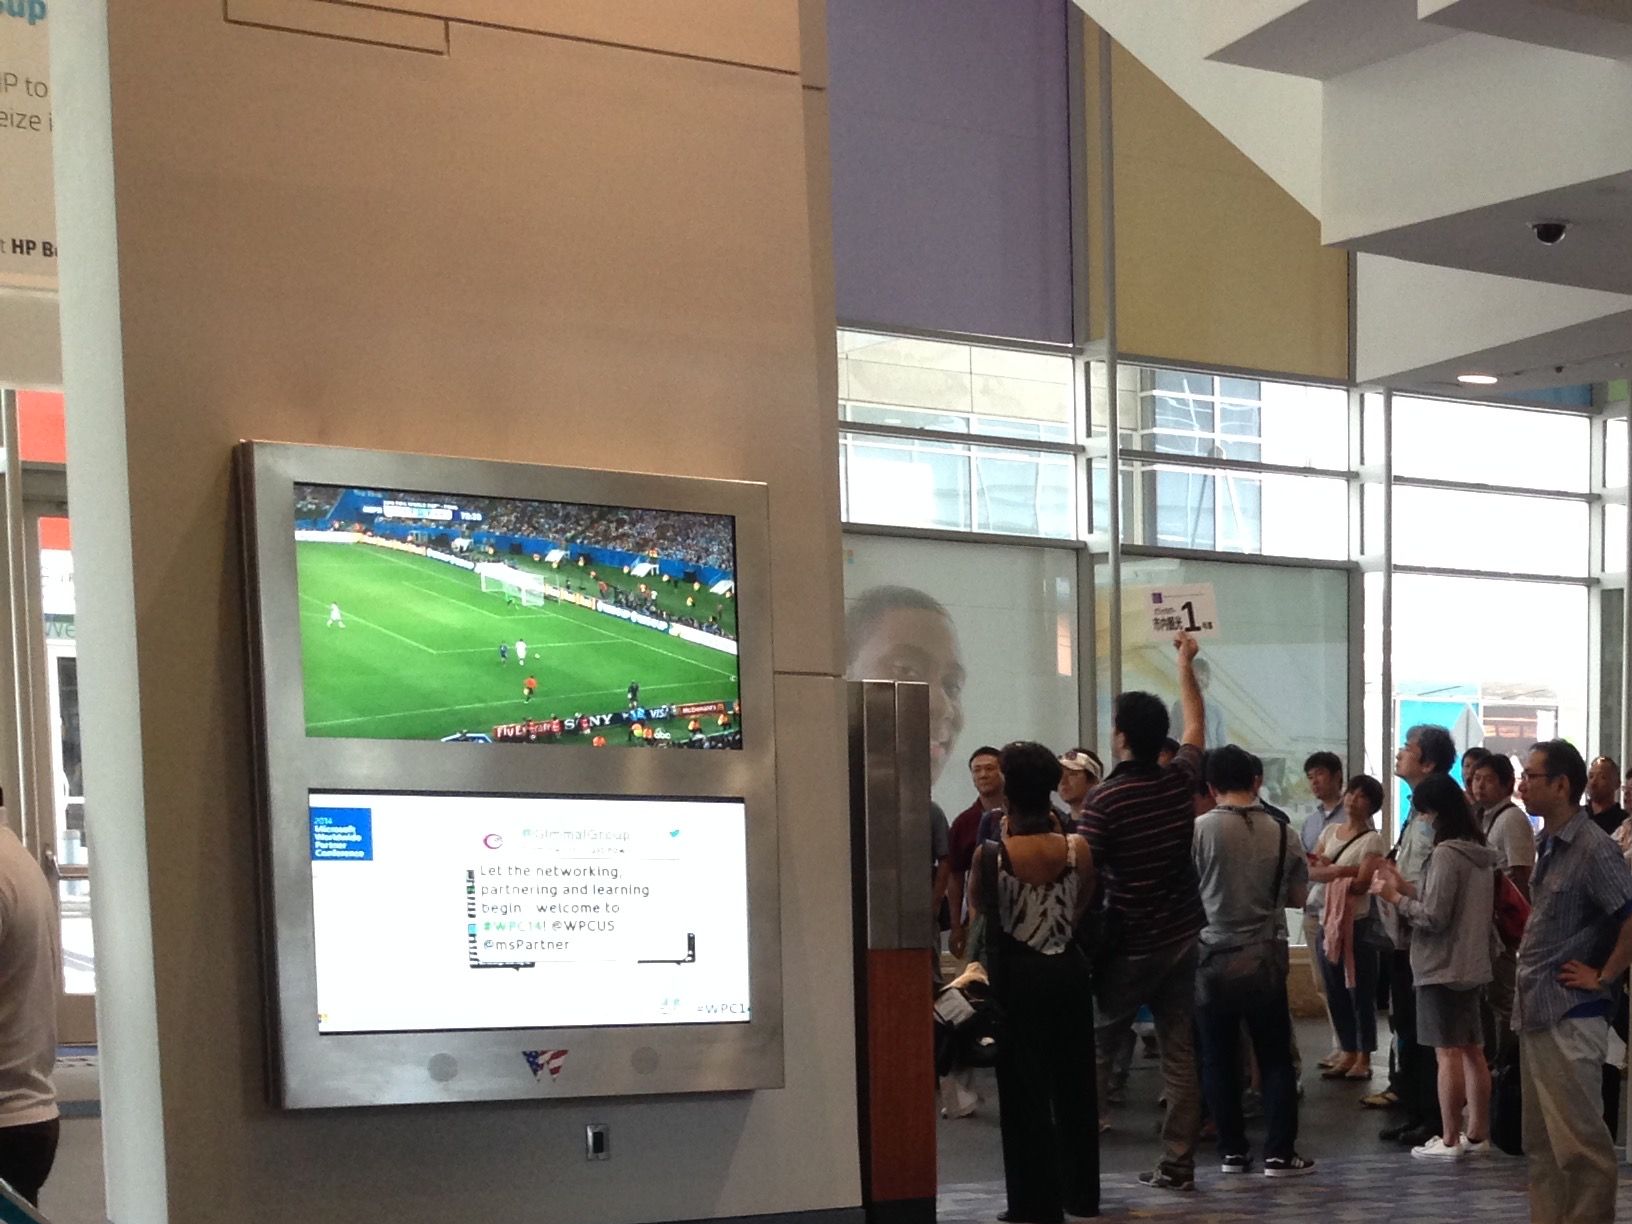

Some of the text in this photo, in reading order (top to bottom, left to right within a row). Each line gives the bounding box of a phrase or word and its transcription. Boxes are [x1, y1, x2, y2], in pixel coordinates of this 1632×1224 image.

[25, 76, 48, 98] to
[11, 238, 36, 257] HP
[42, 240, 58, 258] B
[313, 825, 356, 834] Microsoft
[313, 833, 363, 843] Worldwide
[314, 841, 348, 849] Partner
[314, 848, 365, 858] Conference
[480, 865, 623, 880] Let the networking,
[480, 884, 651, 898] partnering and learning
[536, 903, 602, 914] welcome
[604, 903, 621, 914] to
[551, 920, 616, 932] @WPCUS
[483, 938, 571, 951] @msPartner
